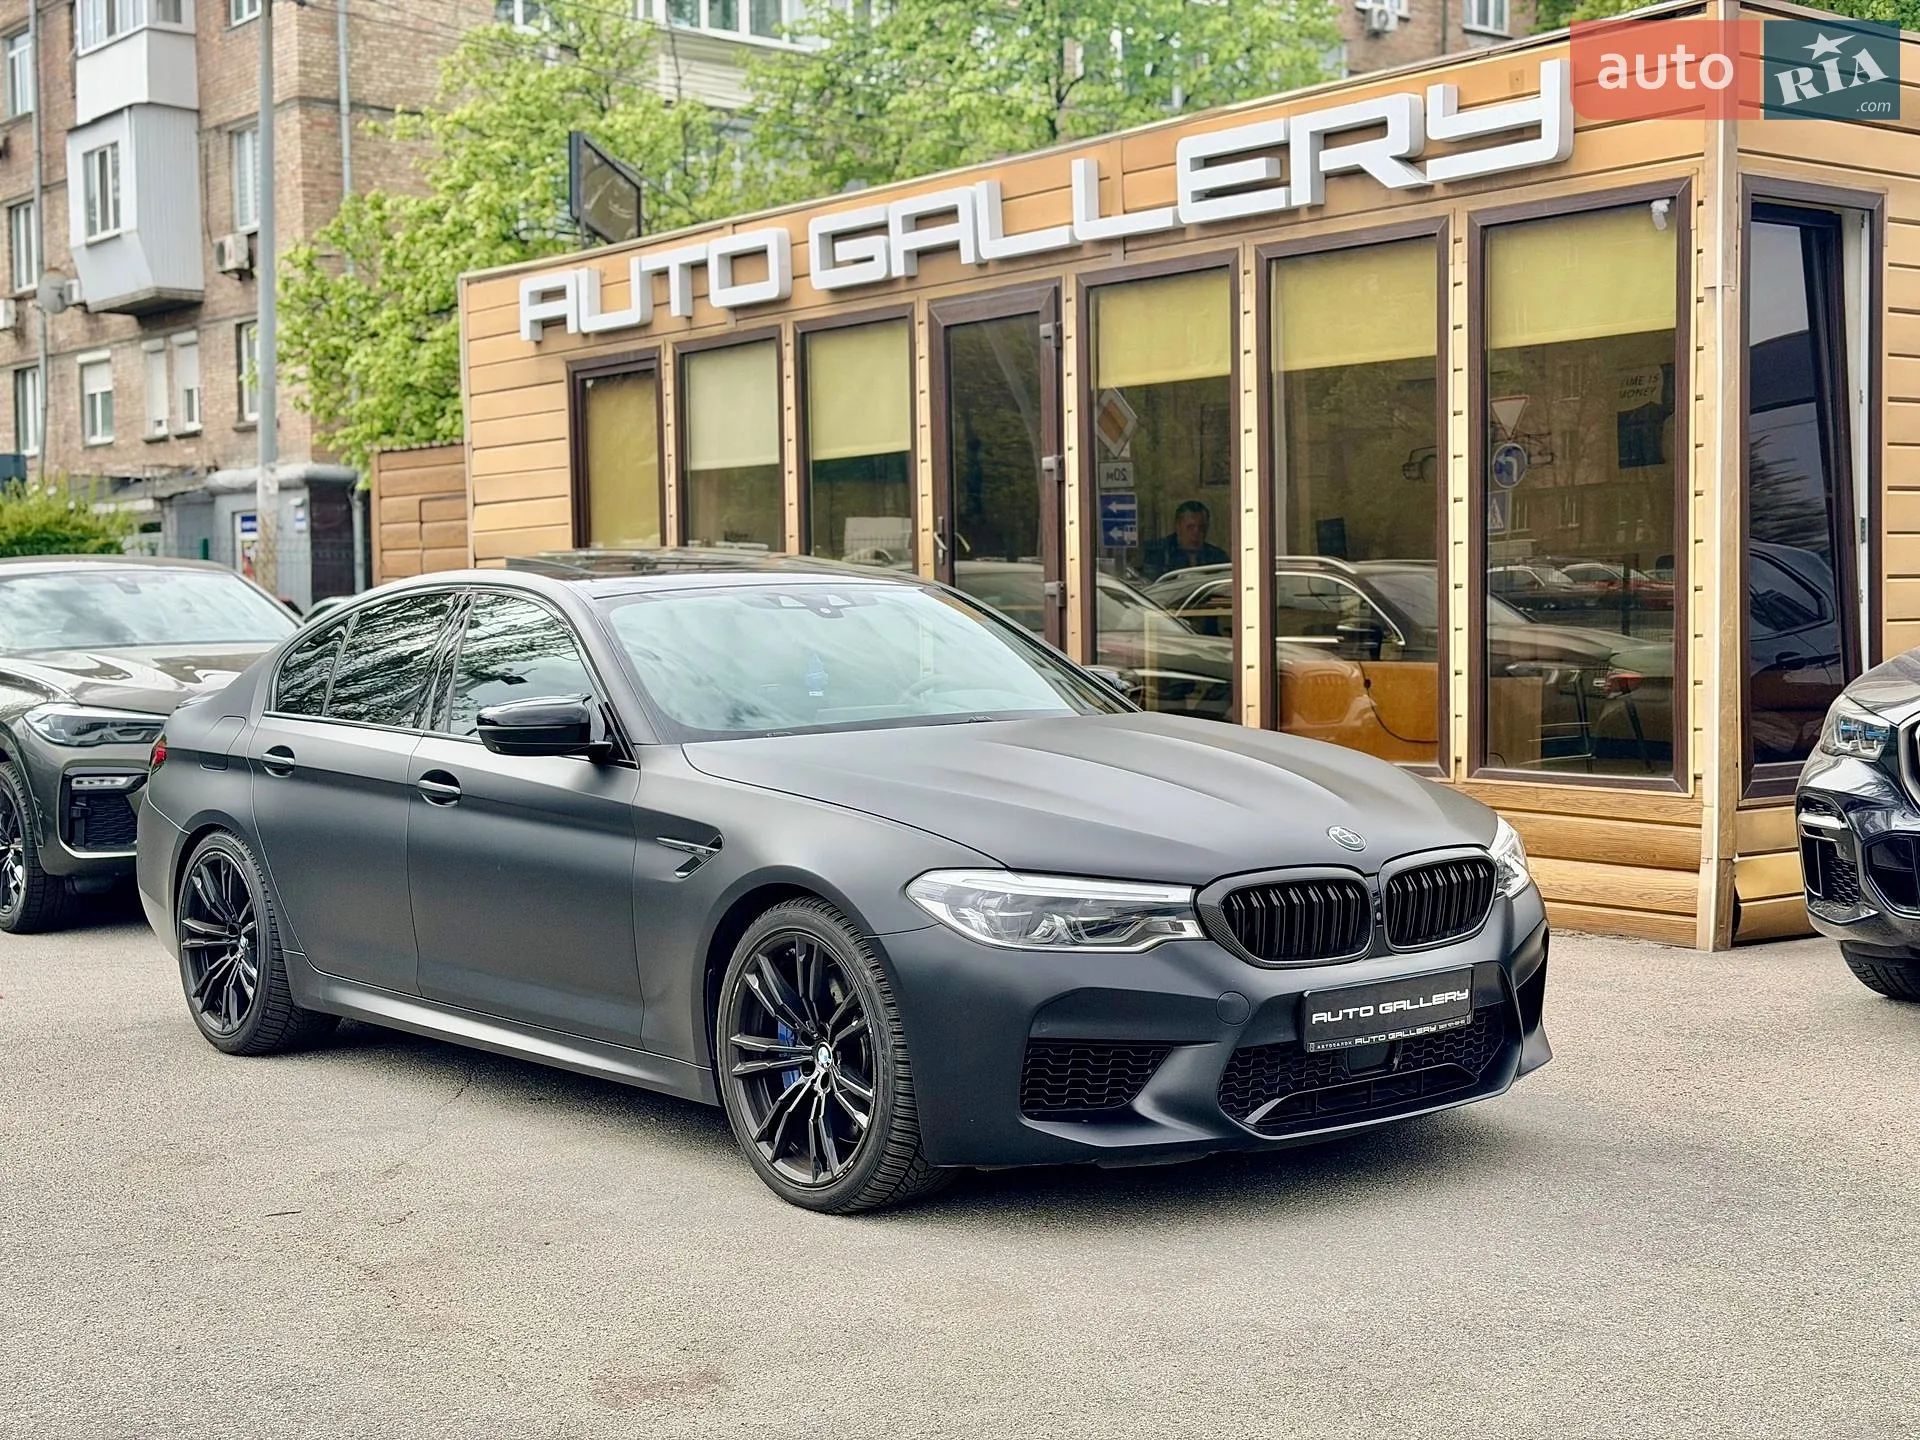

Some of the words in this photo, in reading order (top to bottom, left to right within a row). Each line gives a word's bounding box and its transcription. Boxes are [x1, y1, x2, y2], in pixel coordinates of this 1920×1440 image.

[519, 227, 792, 342] AUTO
[807, 58, 1574, 290] GALLERY
[1618, 386, 1657, 399] MONEY
[1312, 1005, 1374, 1025] AUTO
[1379, 988, 1469, 1015] GALLERY
[1355, 1034, 1386, 1045] AUTO
[1388, 1025, 1437, 1039] GALLERY
